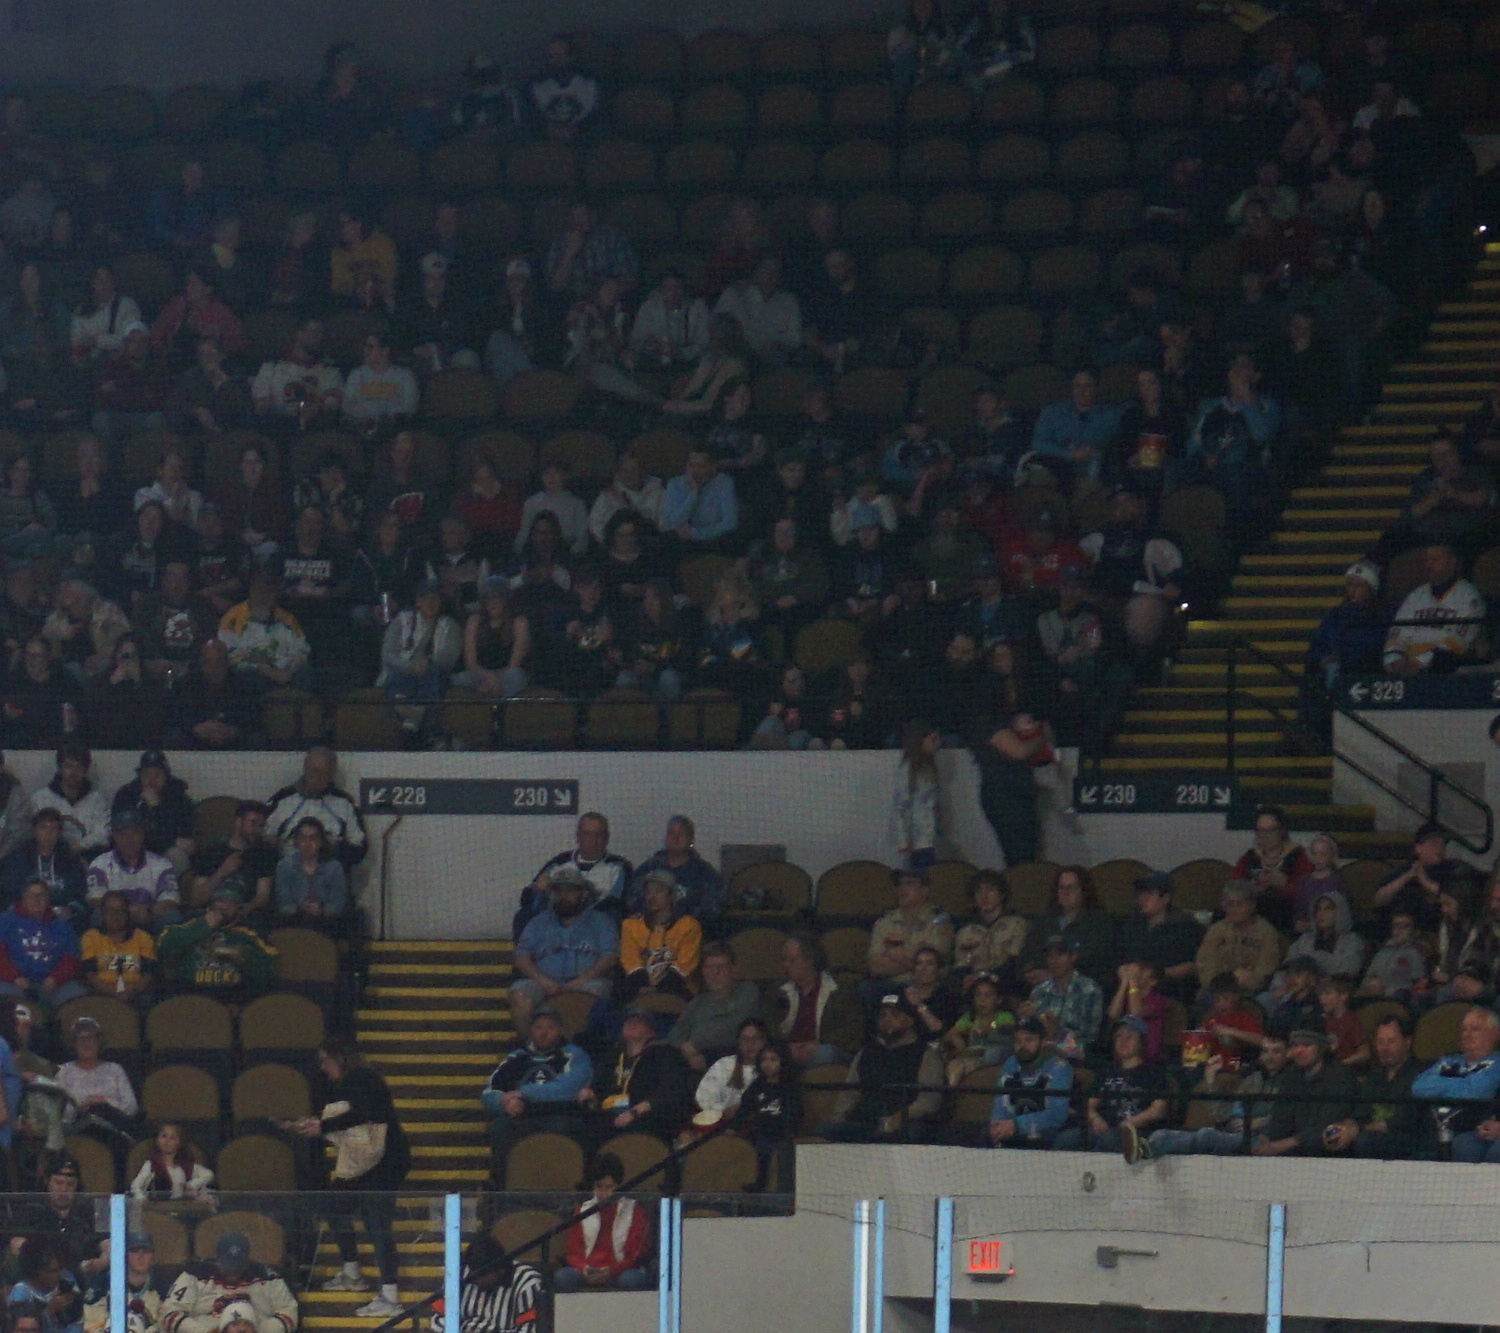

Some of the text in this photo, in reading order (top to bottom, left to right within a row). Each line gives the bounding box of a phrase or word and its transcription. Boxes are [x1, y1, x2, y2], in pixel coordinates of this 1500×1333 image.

[1372, 679, 1405, 702] 329
[391, 785, 548, 807] 228 230
[1102, 783, 1210, 805] 230 230
[969, 1241, 1000, 1270] EXIT
